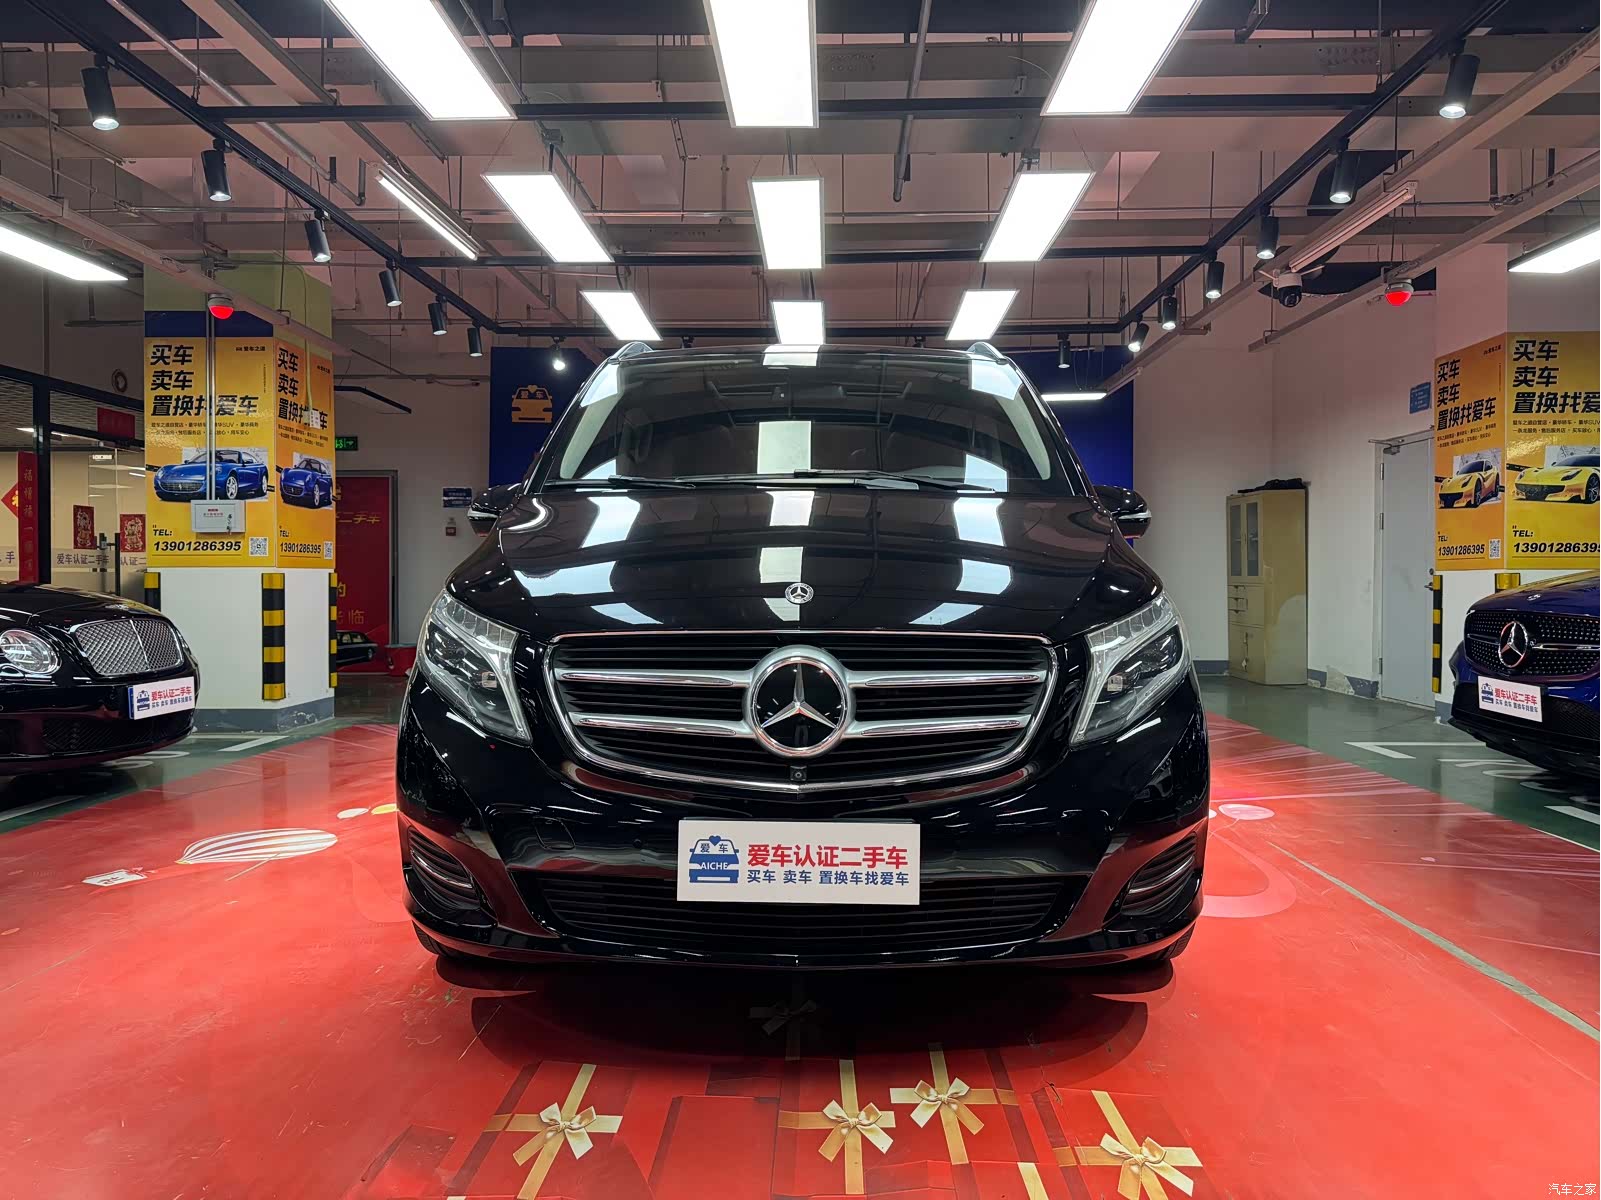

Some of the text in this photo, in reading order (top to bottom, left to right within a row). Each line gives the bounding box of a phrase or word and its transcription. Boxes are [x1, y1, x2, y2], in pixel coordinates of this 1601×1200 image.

[151, 344, 194, 366] 买车
[278, 347, 299, 373] 买车
[1513, 340, 1559, 362] 买车
[151, 370, 194, 391] 卖车
[1437, 358, 1461, 384] 买车
[1513, 366, 1560, 388] 卖车
[278, 373, 299, 398] 卖车
[1437, 383, 1461, 407] 卖车
[1437, 397, 1497, 430] 置换找爱车
[153, 529, 173, 537] TEL:
[153, 541, 241, 552] 13901286395
[280, 542, 322, 554] 13901286395
[1438, 544, 1485, 556] 13901286395
[57, 553, 110, 565] 爱车认证二手车
[151, 686, 192, 702] 爱车认证二手车
[1495, 687, 1537, 706] 爱车认证二手车
[700, 843, 729, 854] 爱 车
[747, 844, 908, 869] 爱车认证二手车
[701, 861, 729, 871] AICHE
[747, 870, 909, 886] 买车 卖车 置换车找爱车
